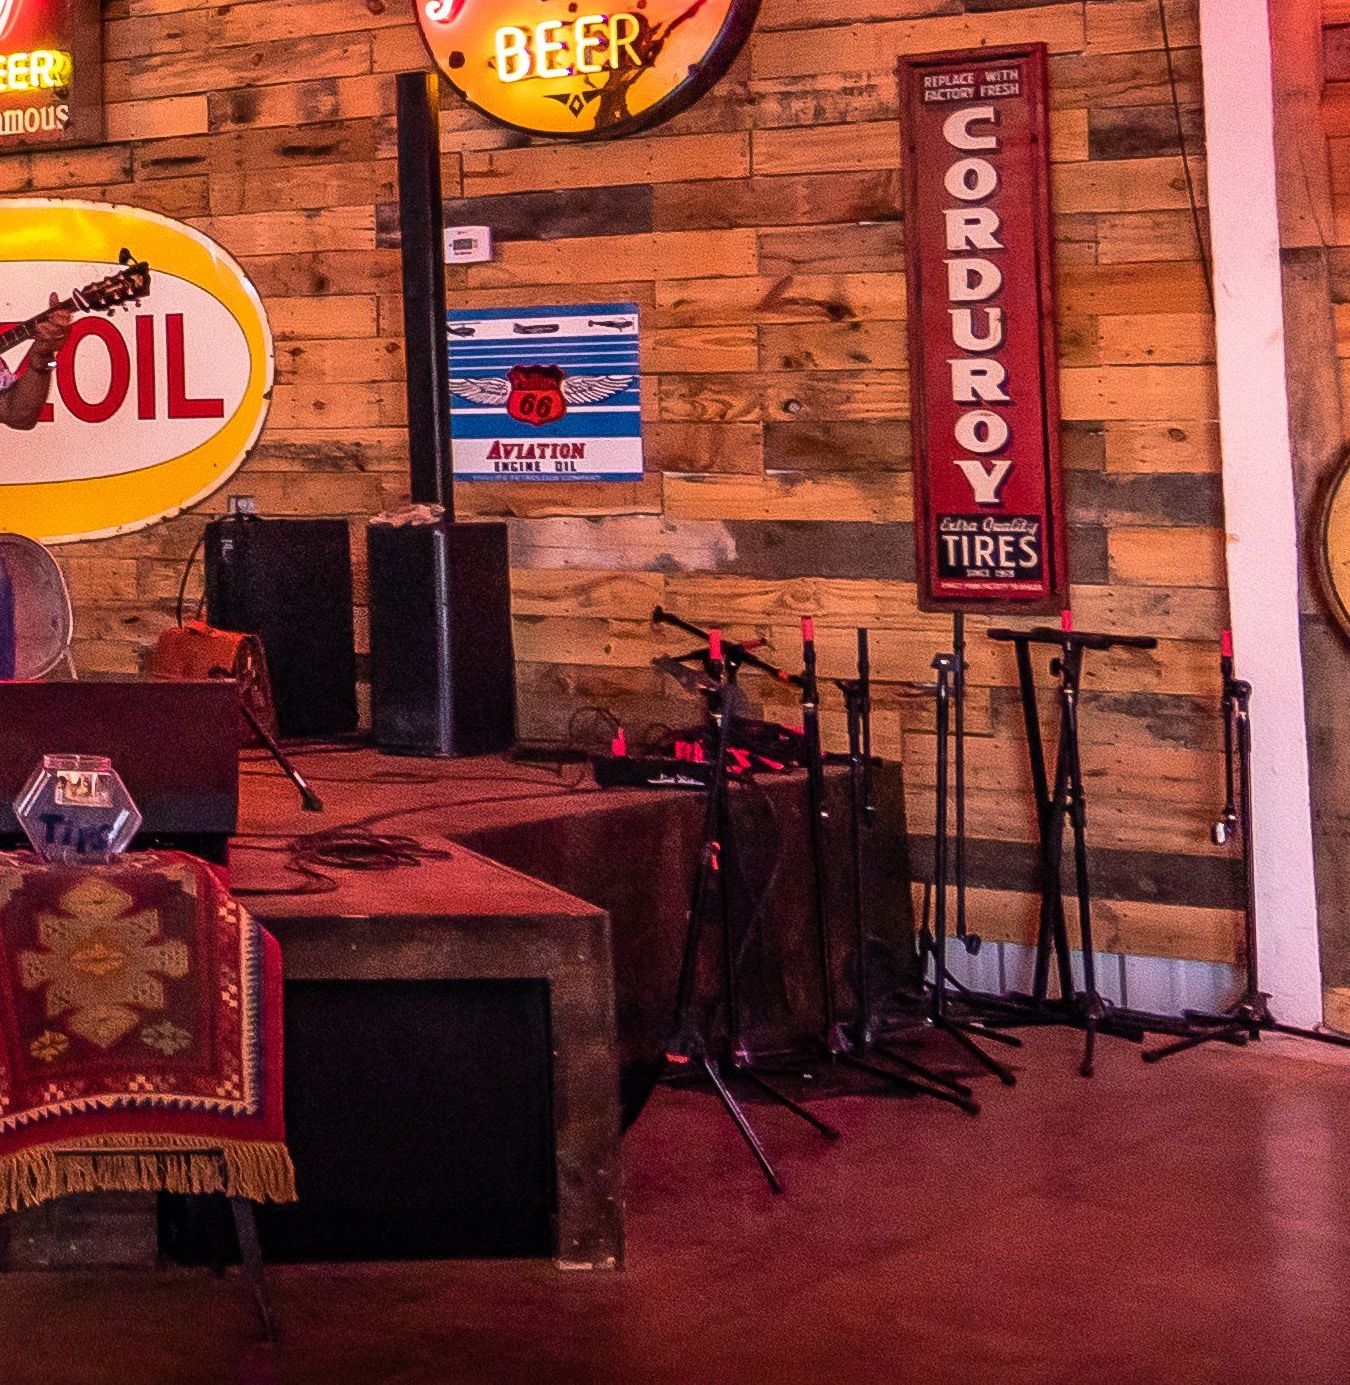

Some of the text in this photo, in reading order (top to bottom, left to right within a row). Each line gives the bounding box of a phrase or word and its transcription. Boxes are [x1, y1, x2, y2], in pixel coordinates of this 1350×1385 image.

[494, 13, 642, 82] BEER
[924, 69, 1019, 88] REPLACE WITH
[924, 82, 1020, 102] FACTORY FRESH
[941, 106, 1014, 505] CORDUROY
[519, 393, 554, 419] 66
[486, 440, 587, 460] AVIATION
[494, 461, 578, 473] ENGINE OIL
[941, 535, 1039, 568] TIRES
